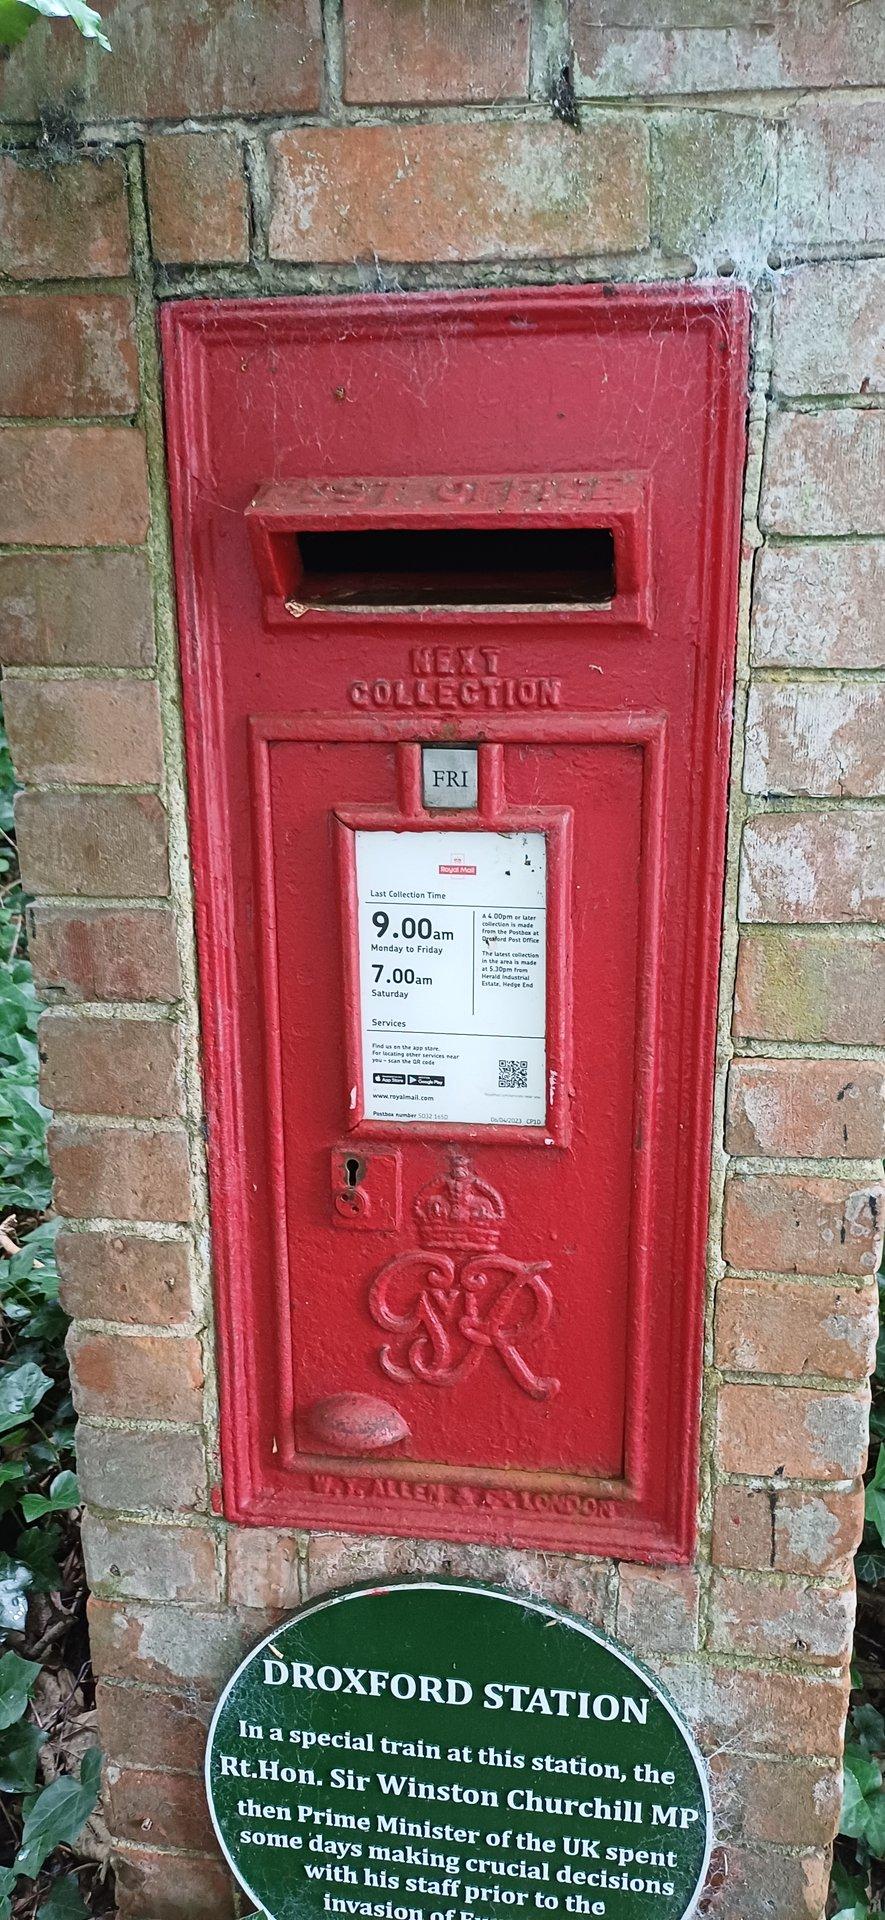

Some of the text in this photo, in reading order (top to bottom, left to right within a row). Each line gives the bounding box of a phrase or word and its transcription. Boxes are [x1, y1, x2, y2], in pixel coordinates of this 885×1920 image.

[410, 645, 500, 676] NEXT
[350, 678, 563, 709] COLLECTION
[432, 770, 468, 788] FRI
[370, 889, 446, 900] Last Collection Time
[372, 911, 454, 940] 9.00am
[371, 943, 404, 954] Monday
[417, 945, 443, 955] Friday
[371, 964, 433, 985] 7.00am
[371, 989, 409, 999] Saturday
[371, 1018, 407, 1028] Services
[372, 1478, 450, 1504] ALLEN
[263, 1659, 649, 1724] DROXFORD STATION
[239, 1720, 675, 1785] In a special train at this station, the
[220, 1755, 699, 1829] Rt.Hon. Sir Winston Churchill MP
[237, 1799, 677, 1868] then Prime Minister of the UK spent
[240, 1830, 675, 1896] some days making crucial decisions
[304, 1864, 606, 1916] with his staff prior to the
[323, 1893, 423, 1920] invasion
